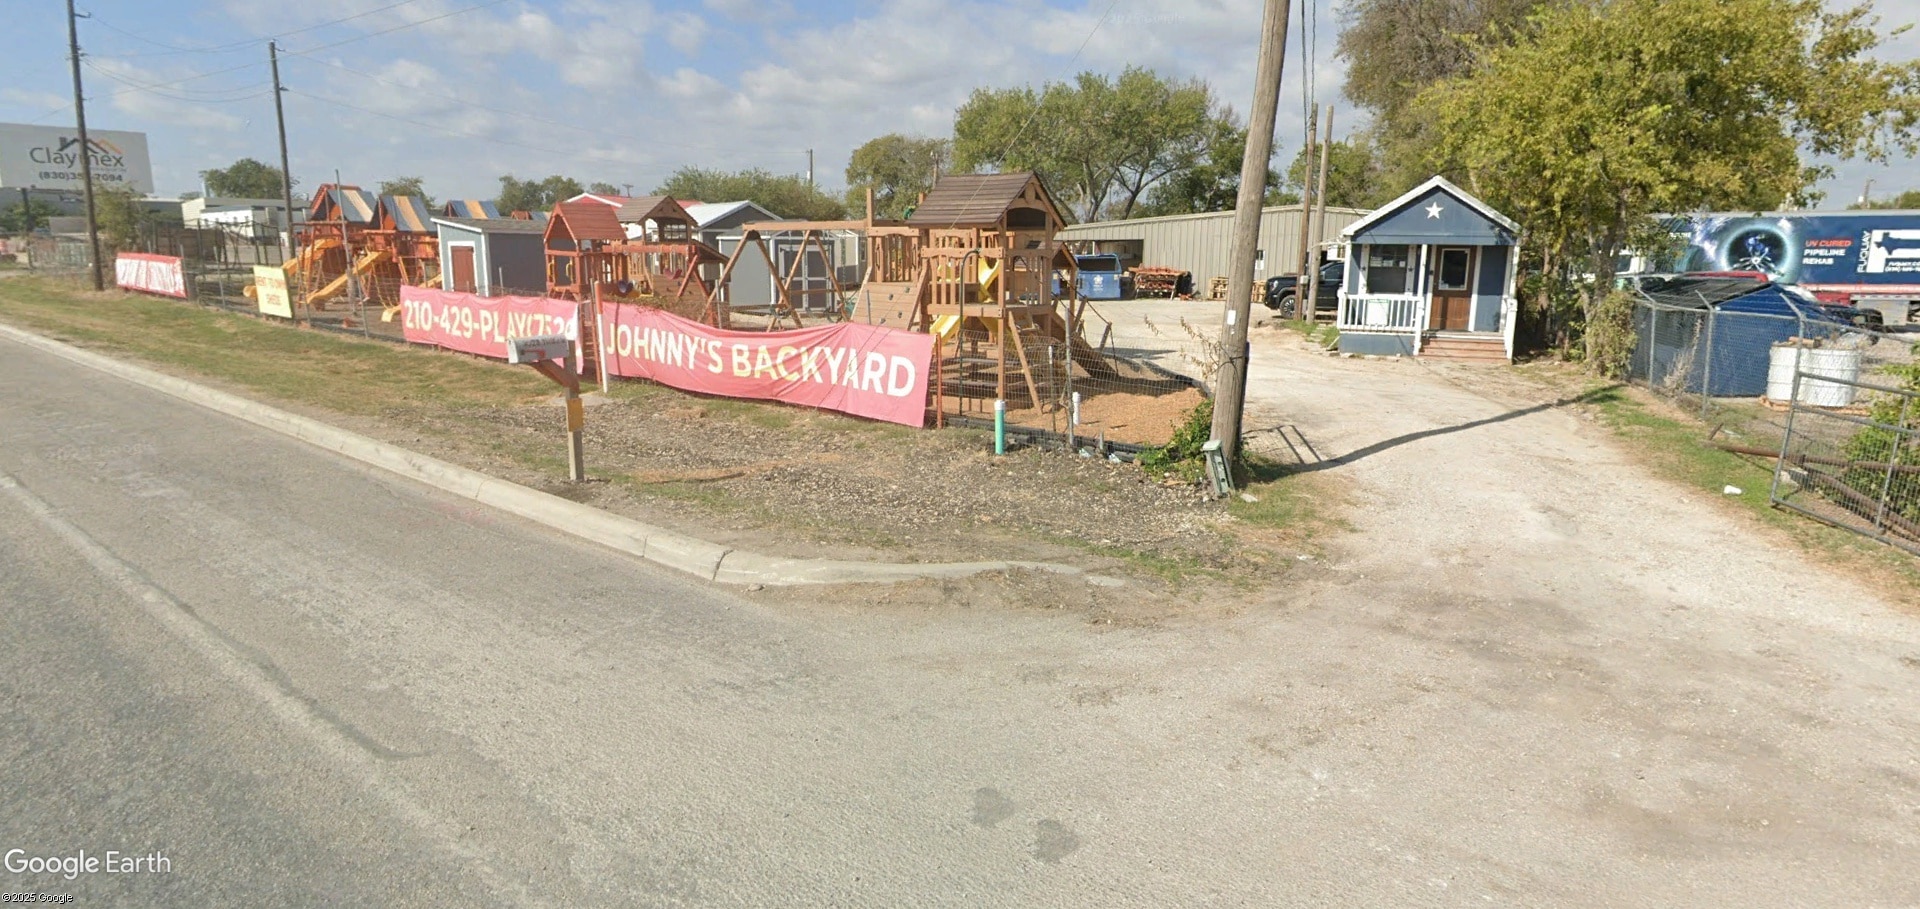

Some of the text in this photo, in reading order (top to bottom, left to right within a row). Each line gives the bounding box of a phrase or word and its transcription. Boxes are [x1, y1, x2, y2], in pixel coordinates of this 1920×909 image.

[1805, 239, 1852, 248] UV CURED
[1803, 248, 1847, 256] PIPELINE
[1857, 230, 1872, 273] FUQUAY
[1802, 257, 1835, 265] REHAB
[606, 324, 917, 397] JOHNNY'S BACKYARD
